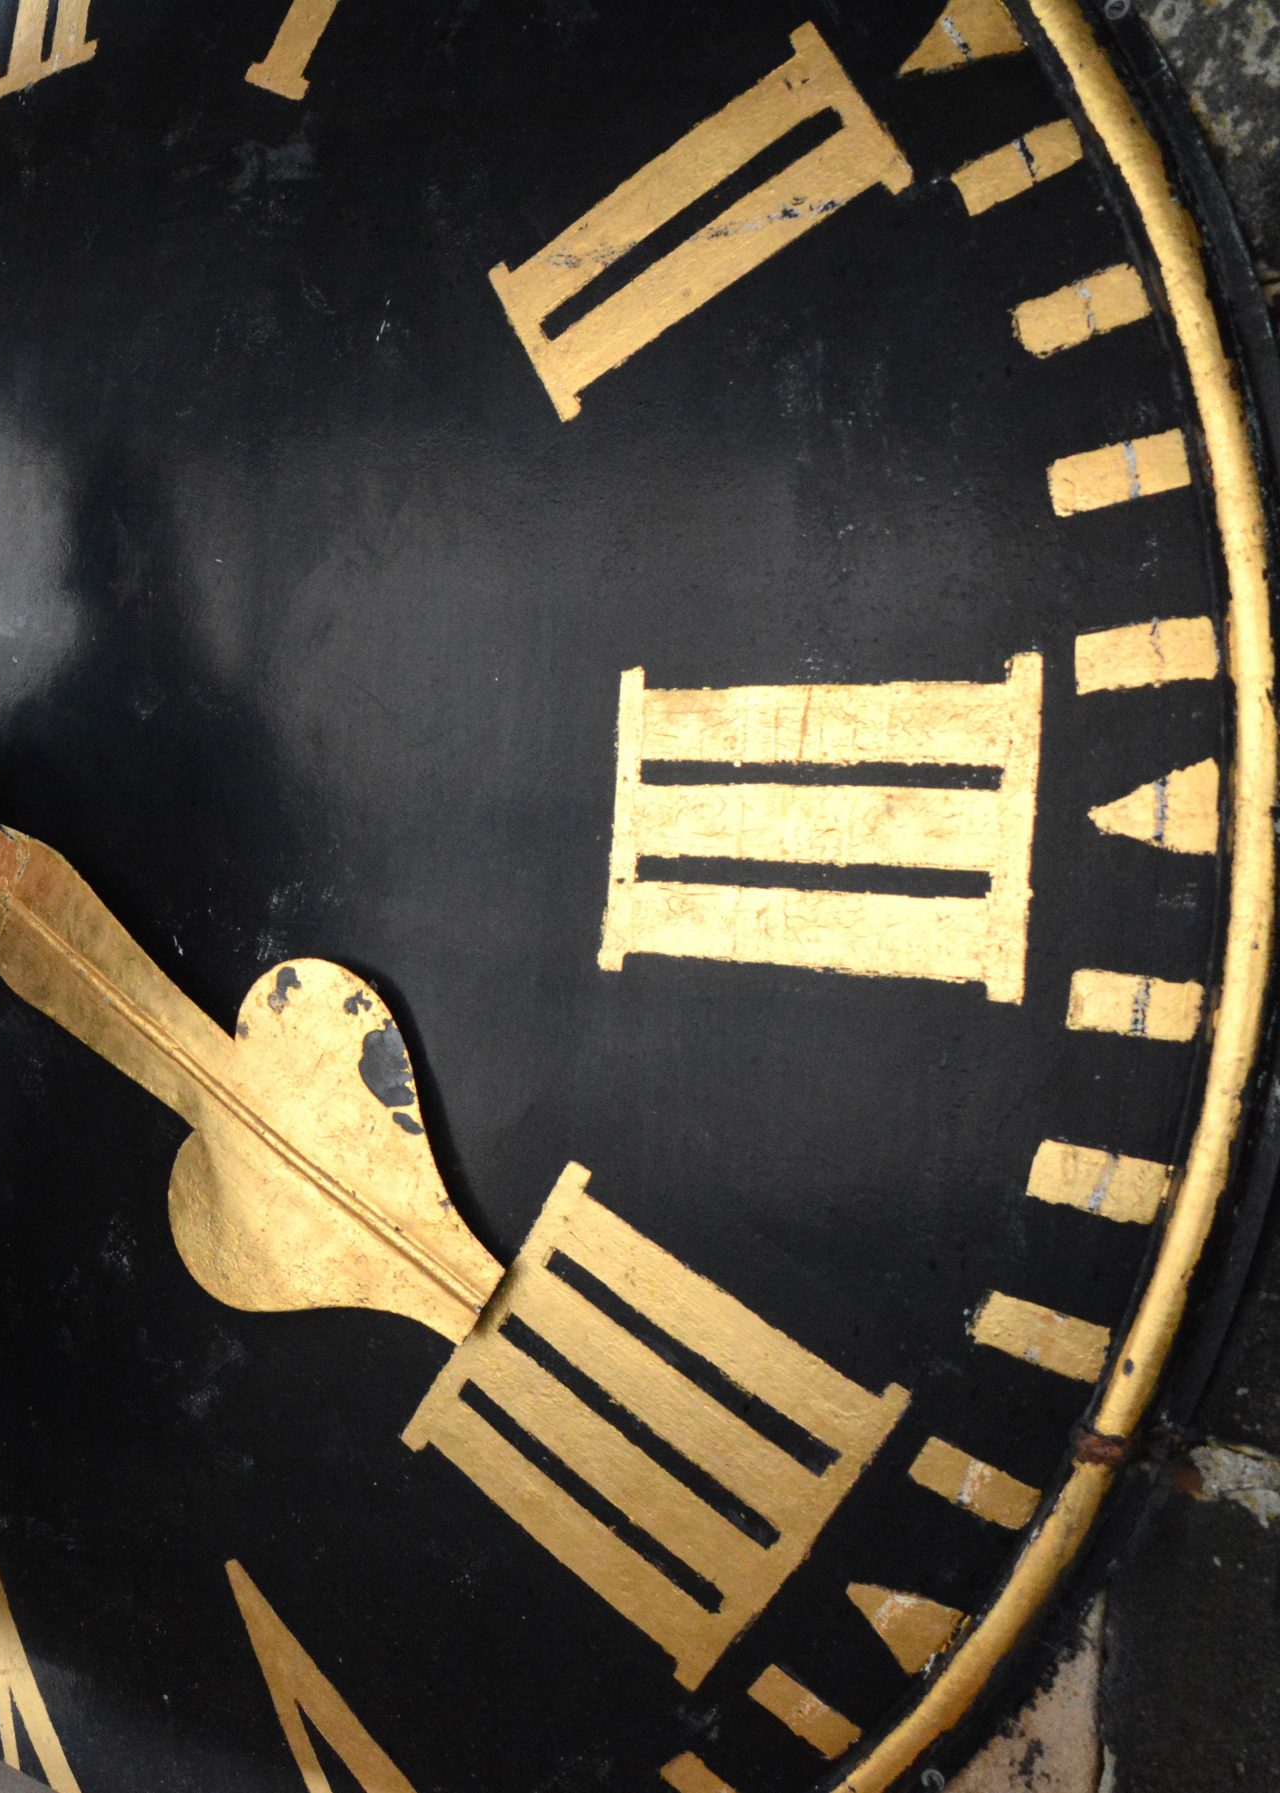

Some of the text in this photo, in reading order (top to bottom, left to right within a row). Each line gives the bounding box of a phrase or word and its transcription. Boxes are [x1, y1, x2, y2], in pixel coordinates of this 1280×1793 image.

[488, 20, 913, 423] II
[597, 651, 1044, 1006] III
[400, 1160, 912, 1693] IIII
